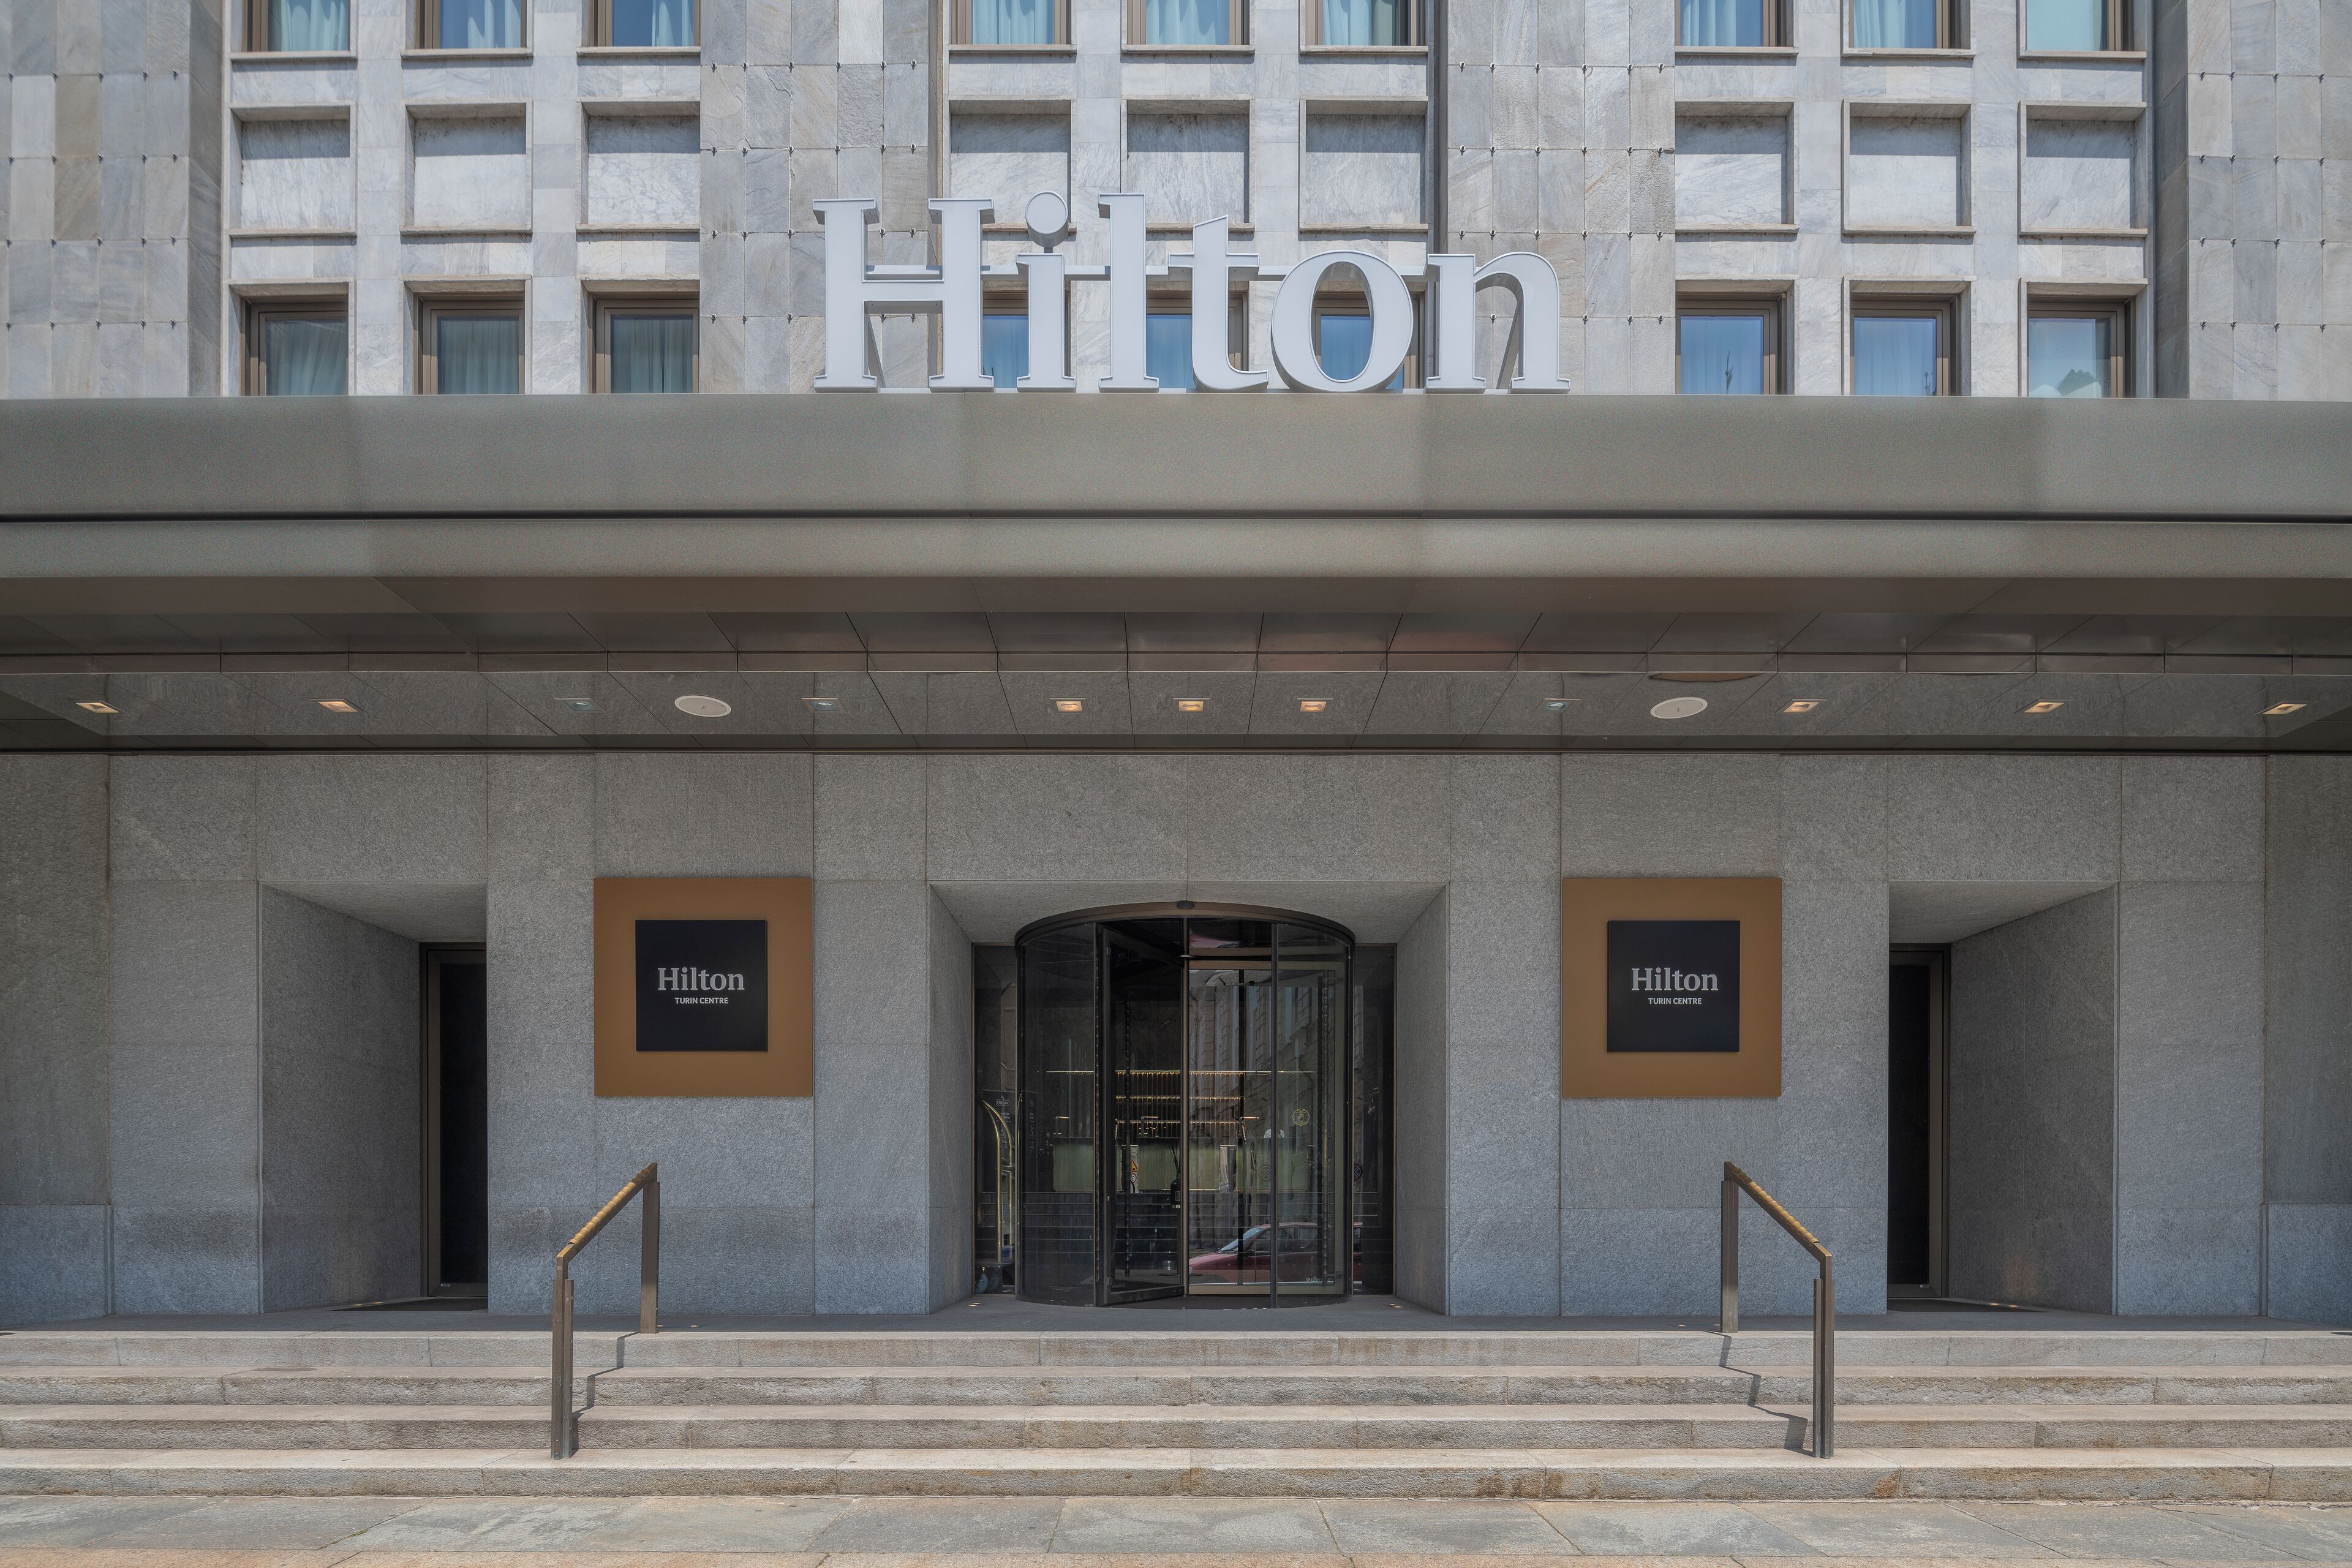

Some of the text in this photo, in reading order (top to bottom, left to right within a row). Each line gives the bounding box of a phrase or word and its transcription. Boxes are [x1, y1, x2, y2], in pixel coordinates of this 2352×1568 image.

[813, 192, 1570, 393] Hilton
[657, 967, 745, 991] Hilton
[1631, 967, 1719, 991] Hilton
